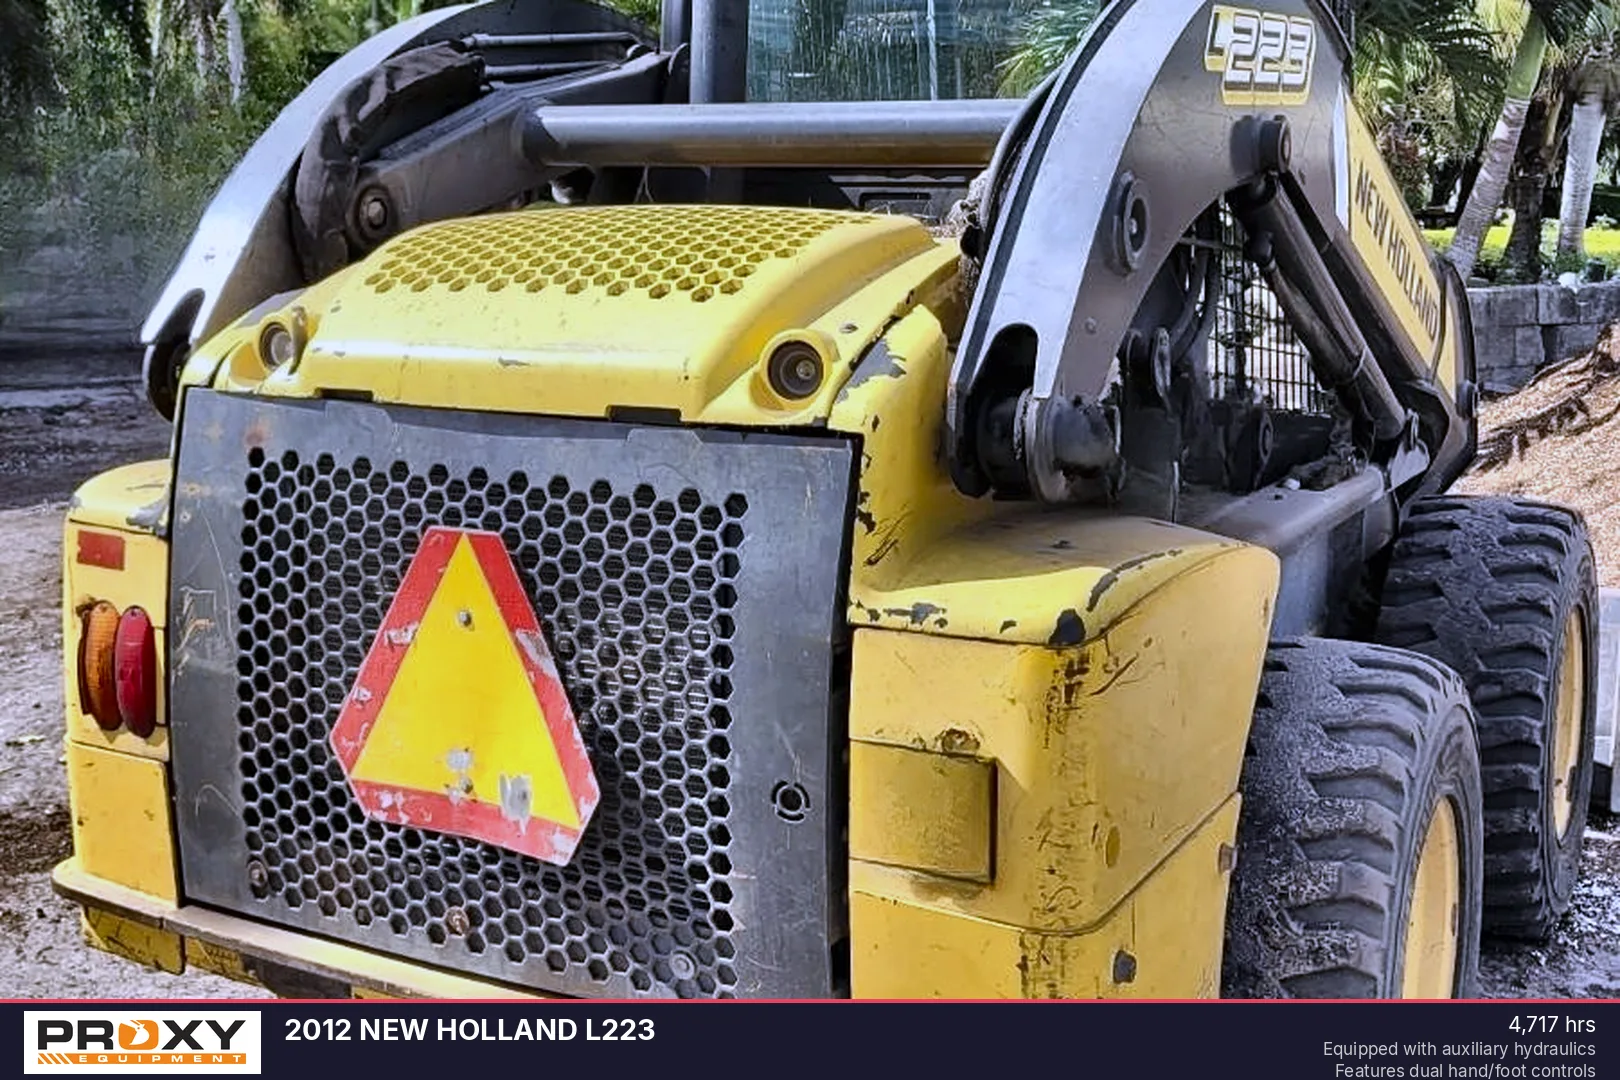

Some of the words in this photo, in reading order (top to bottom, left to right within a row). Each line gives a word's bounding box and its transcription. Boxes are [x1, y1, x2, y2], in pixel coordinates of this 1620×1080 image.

[1204, 4, 1316, 106] L223
[1355, 160, 1389, 250] NEW
[1387, 219, 1439, 342] HOLLAND
